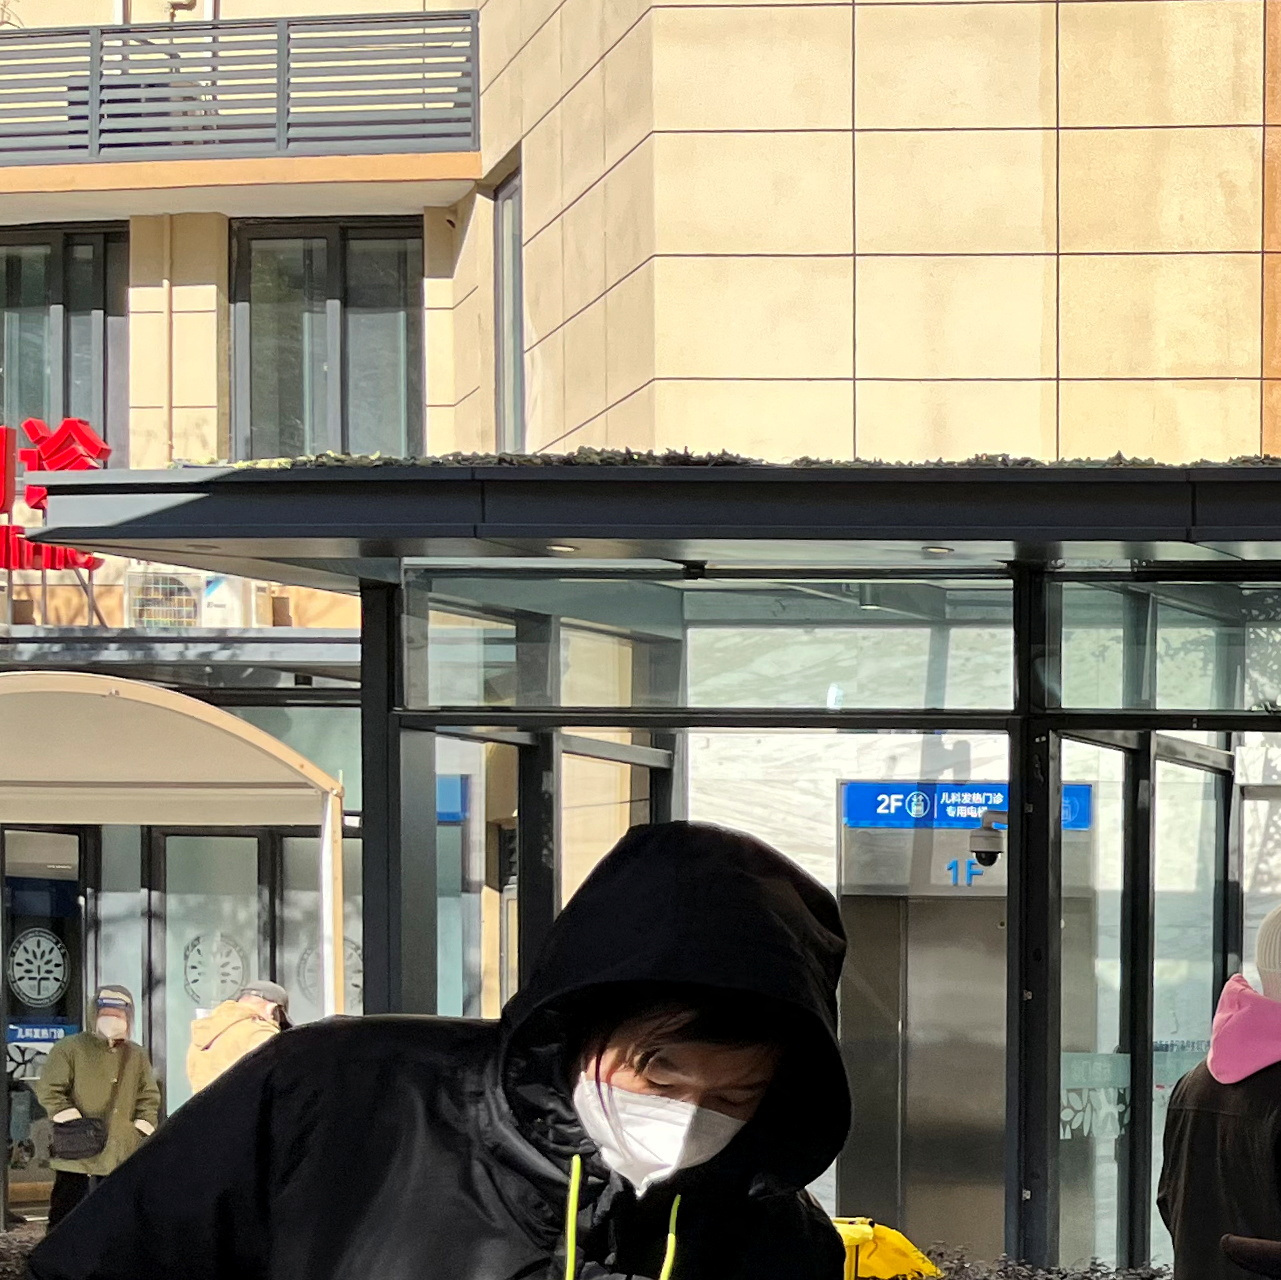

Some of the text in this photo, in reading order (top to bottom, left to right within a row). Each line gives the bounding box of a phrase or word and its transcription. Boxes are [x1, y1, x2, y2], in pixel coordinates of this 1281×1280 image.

[876, 794, 904, 814] 2F
[940, 791, 1004, 804] 儿科发热门诊
